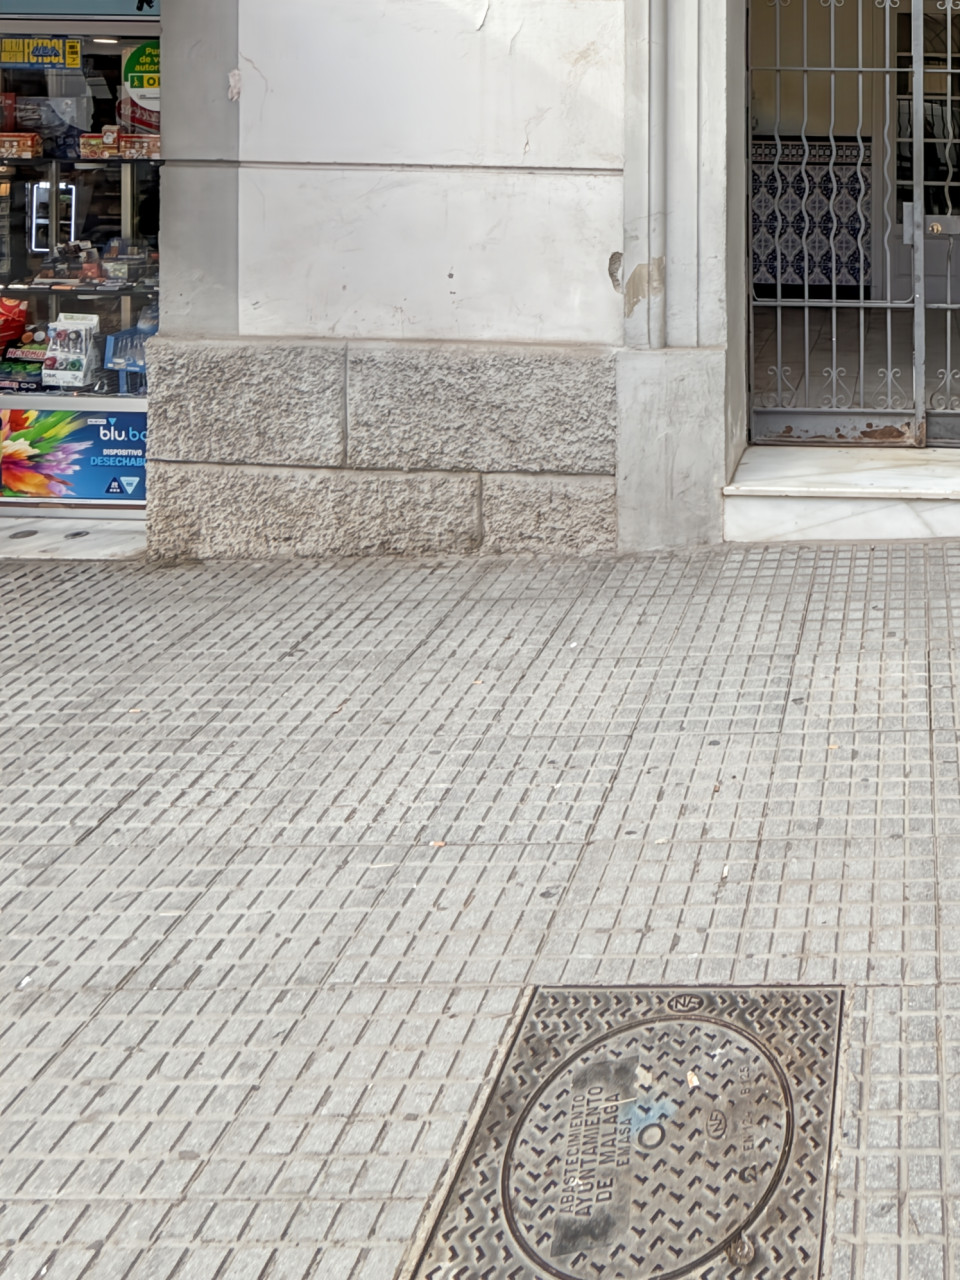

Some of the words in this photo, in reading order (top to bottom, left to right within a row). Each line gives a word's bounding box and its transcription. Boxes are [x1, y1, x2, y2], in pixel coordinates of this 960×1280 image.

[559, 1094, 585, 1213] ABASTECIMIENTO
[575, 1086, 603, 1217] AYUNTAMIENTO
[599, 1092, 620, 1166] MALAGA
[616, 1117, 632, 1167] EMASA
[596, 1177, 614, 1203] DE
